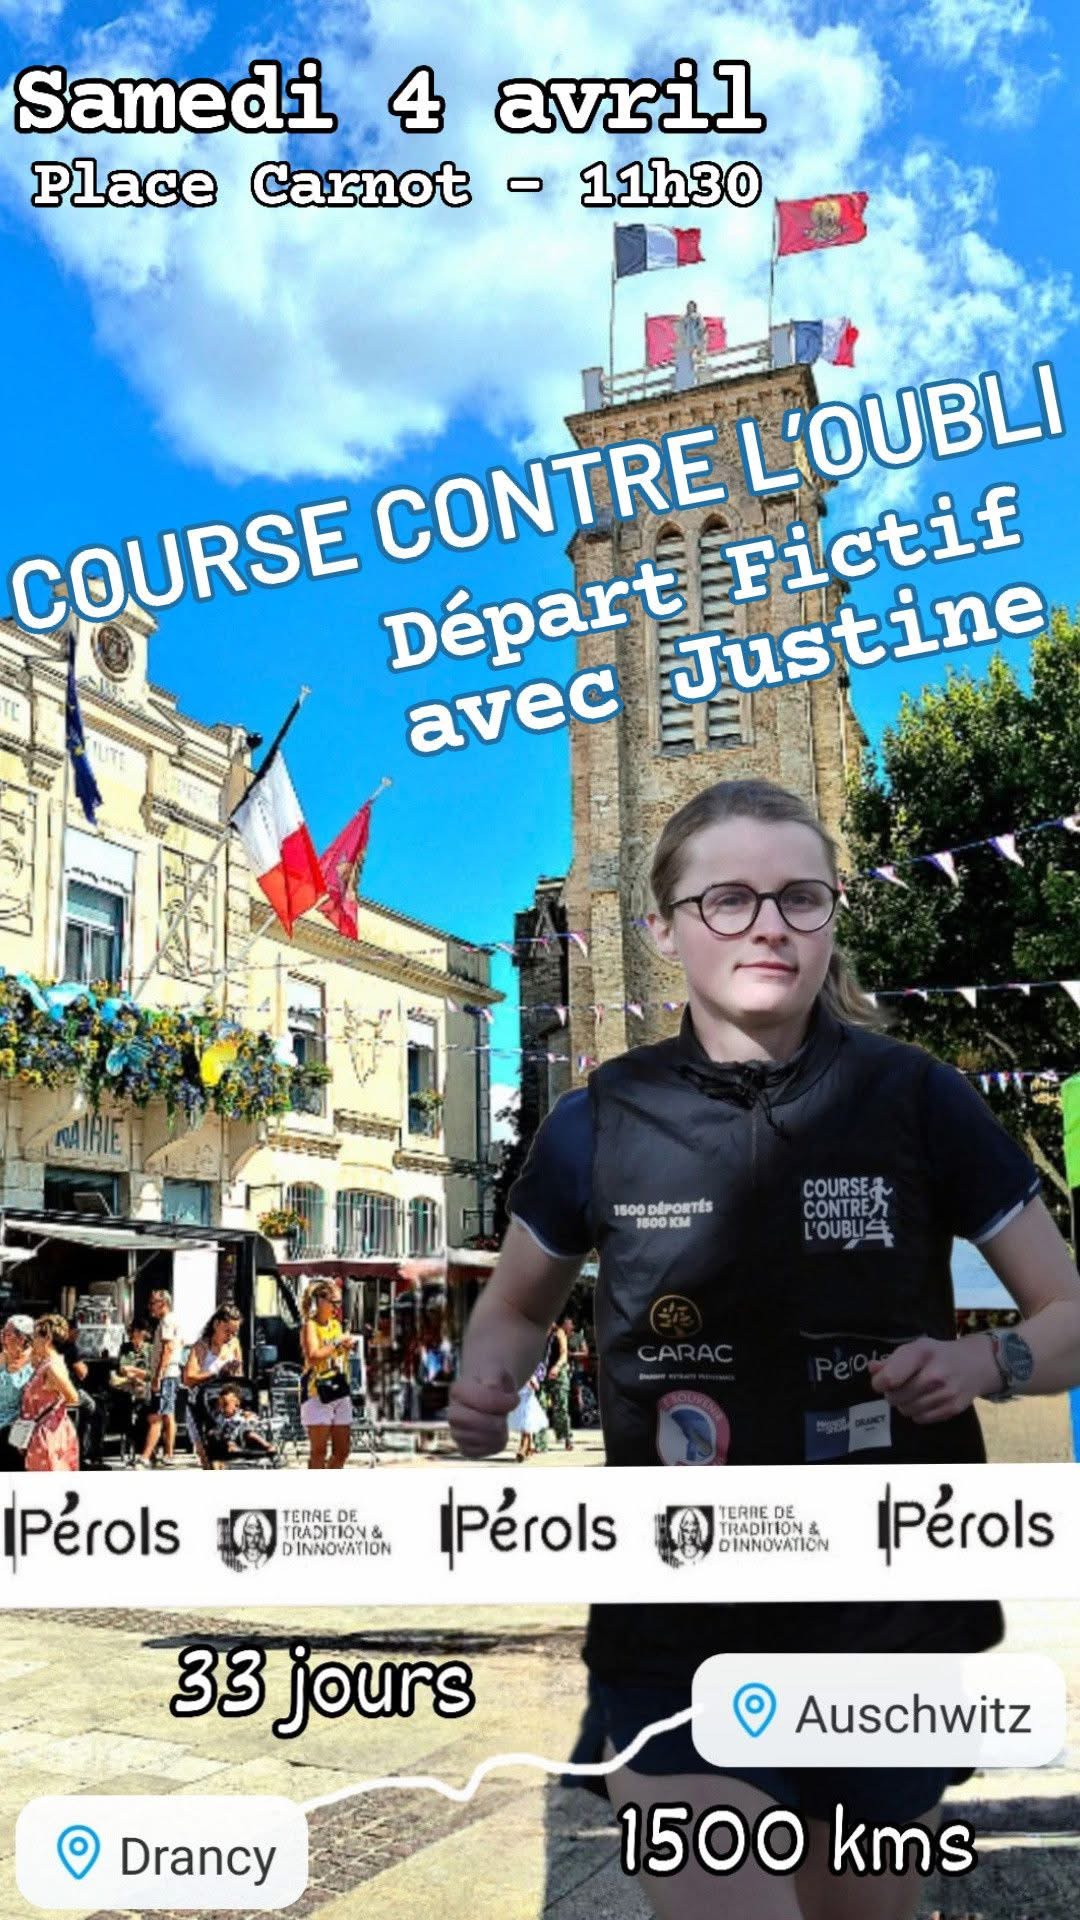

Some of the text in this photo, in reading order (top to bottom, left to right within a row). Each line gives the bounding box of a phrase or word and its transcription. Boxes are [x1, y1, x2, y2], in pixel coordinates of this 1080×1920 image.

[804, 1178, 868, 1198] COURSE
[614, 1203, 646, 1216] 1500
[804, 1198, 869, 1218] CONTRE
[805, 1219, 864, 1240] L'OUBLI
[638, 1344, 733, 1363] CARAC
